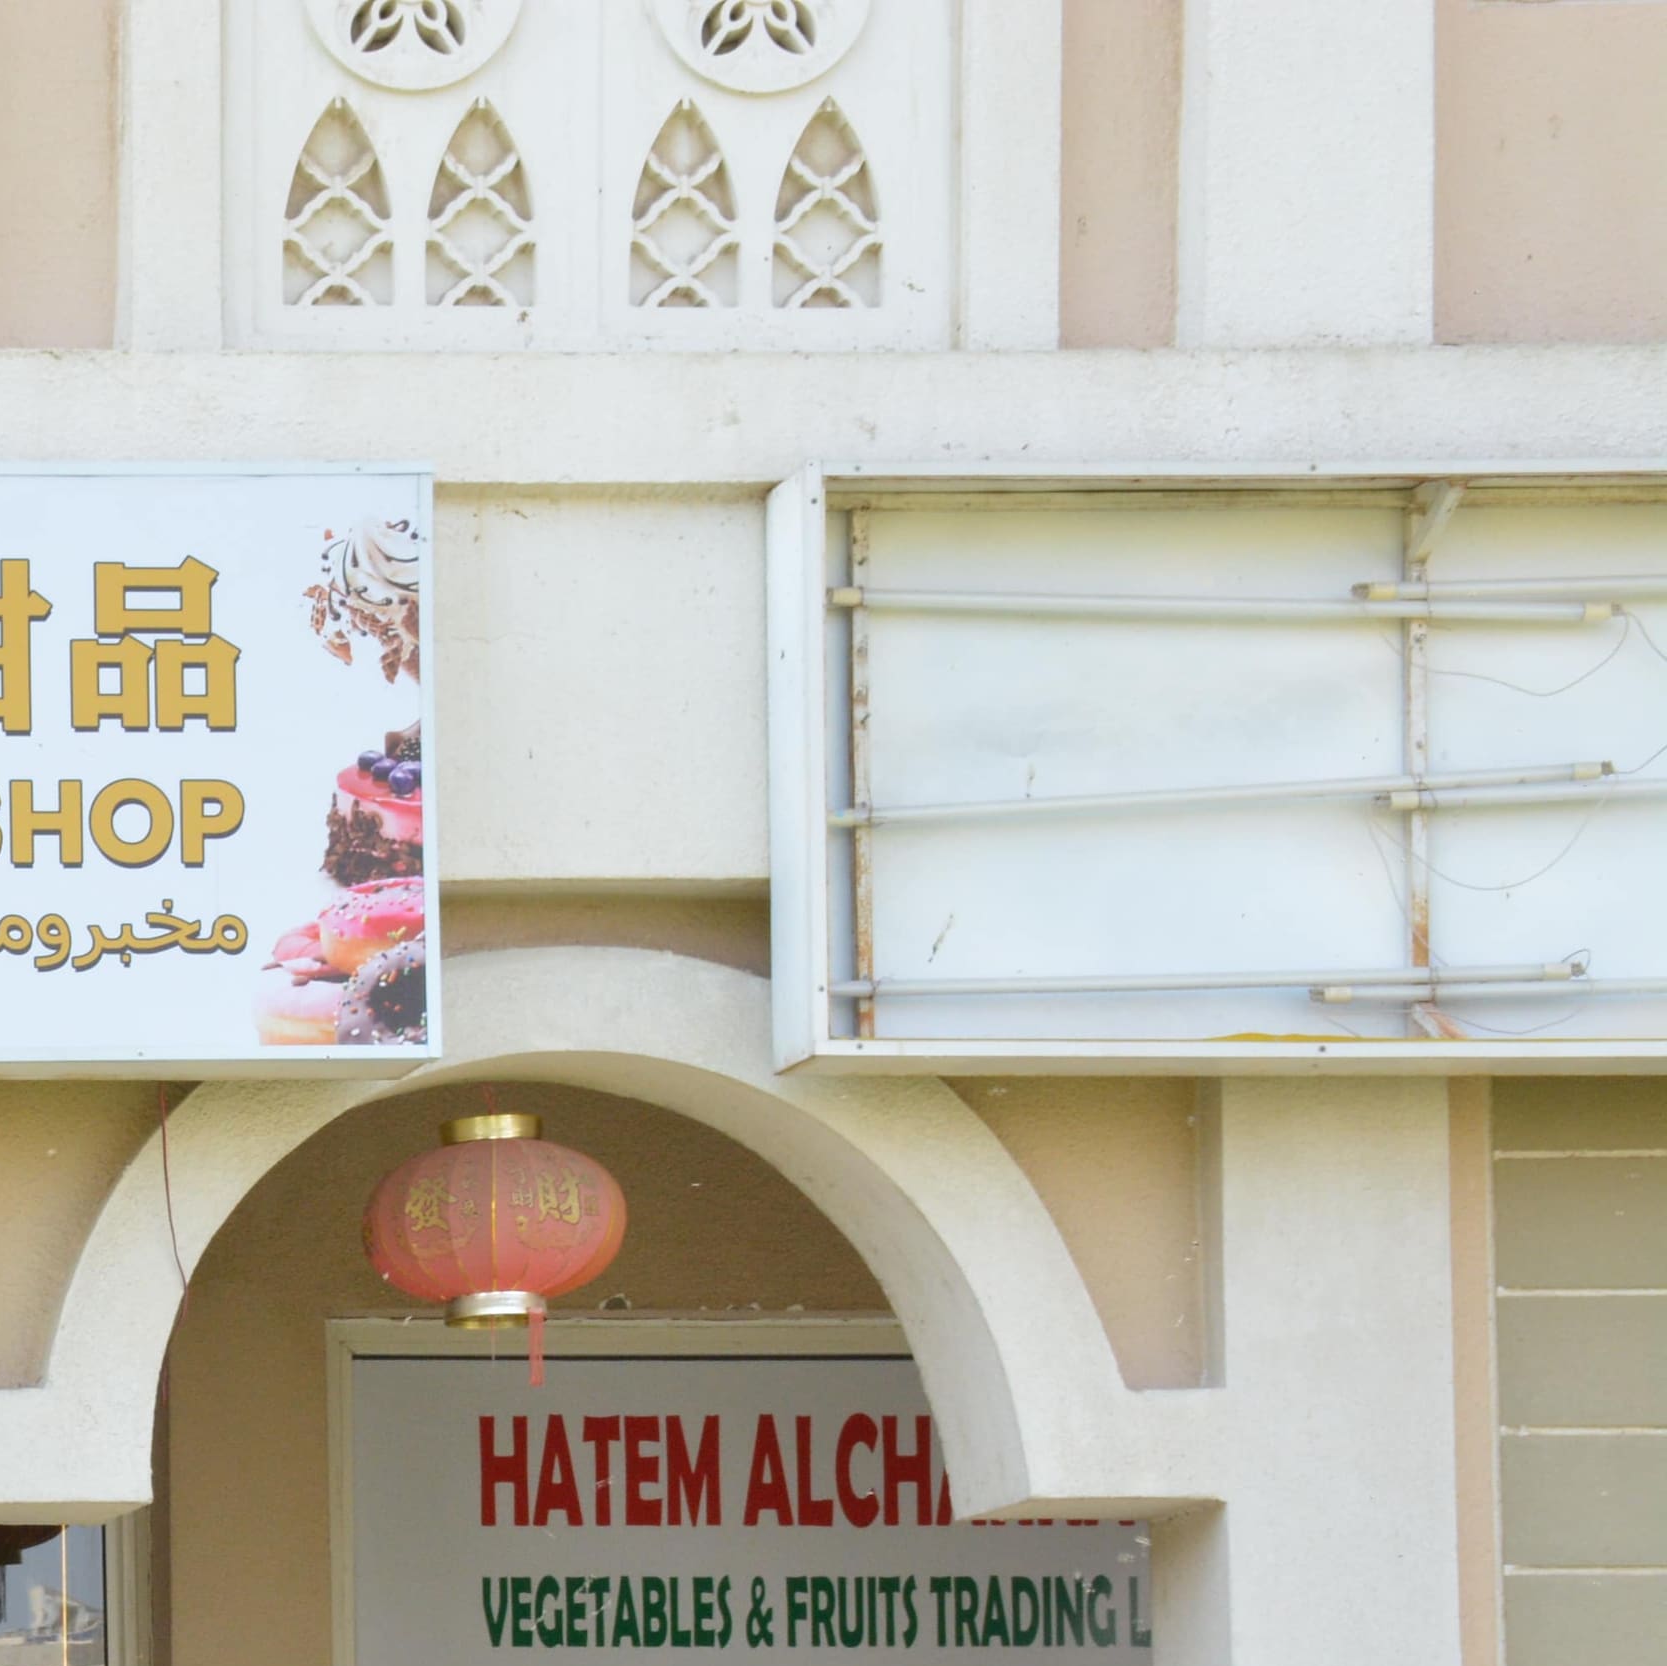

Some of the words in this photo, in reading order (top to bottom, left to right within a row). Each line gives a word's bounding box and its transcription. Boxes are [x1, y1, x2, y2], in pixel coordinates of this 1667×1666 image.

[479, 1414, 721, 1527] HATEM
[482, 1575, 733, 1648] VEGETABLES
[746, 1576, 774, 1648] &
[786, 1575, 918, 1648] FRUITS
[930, 1575, 1116, 1648] TRADING
